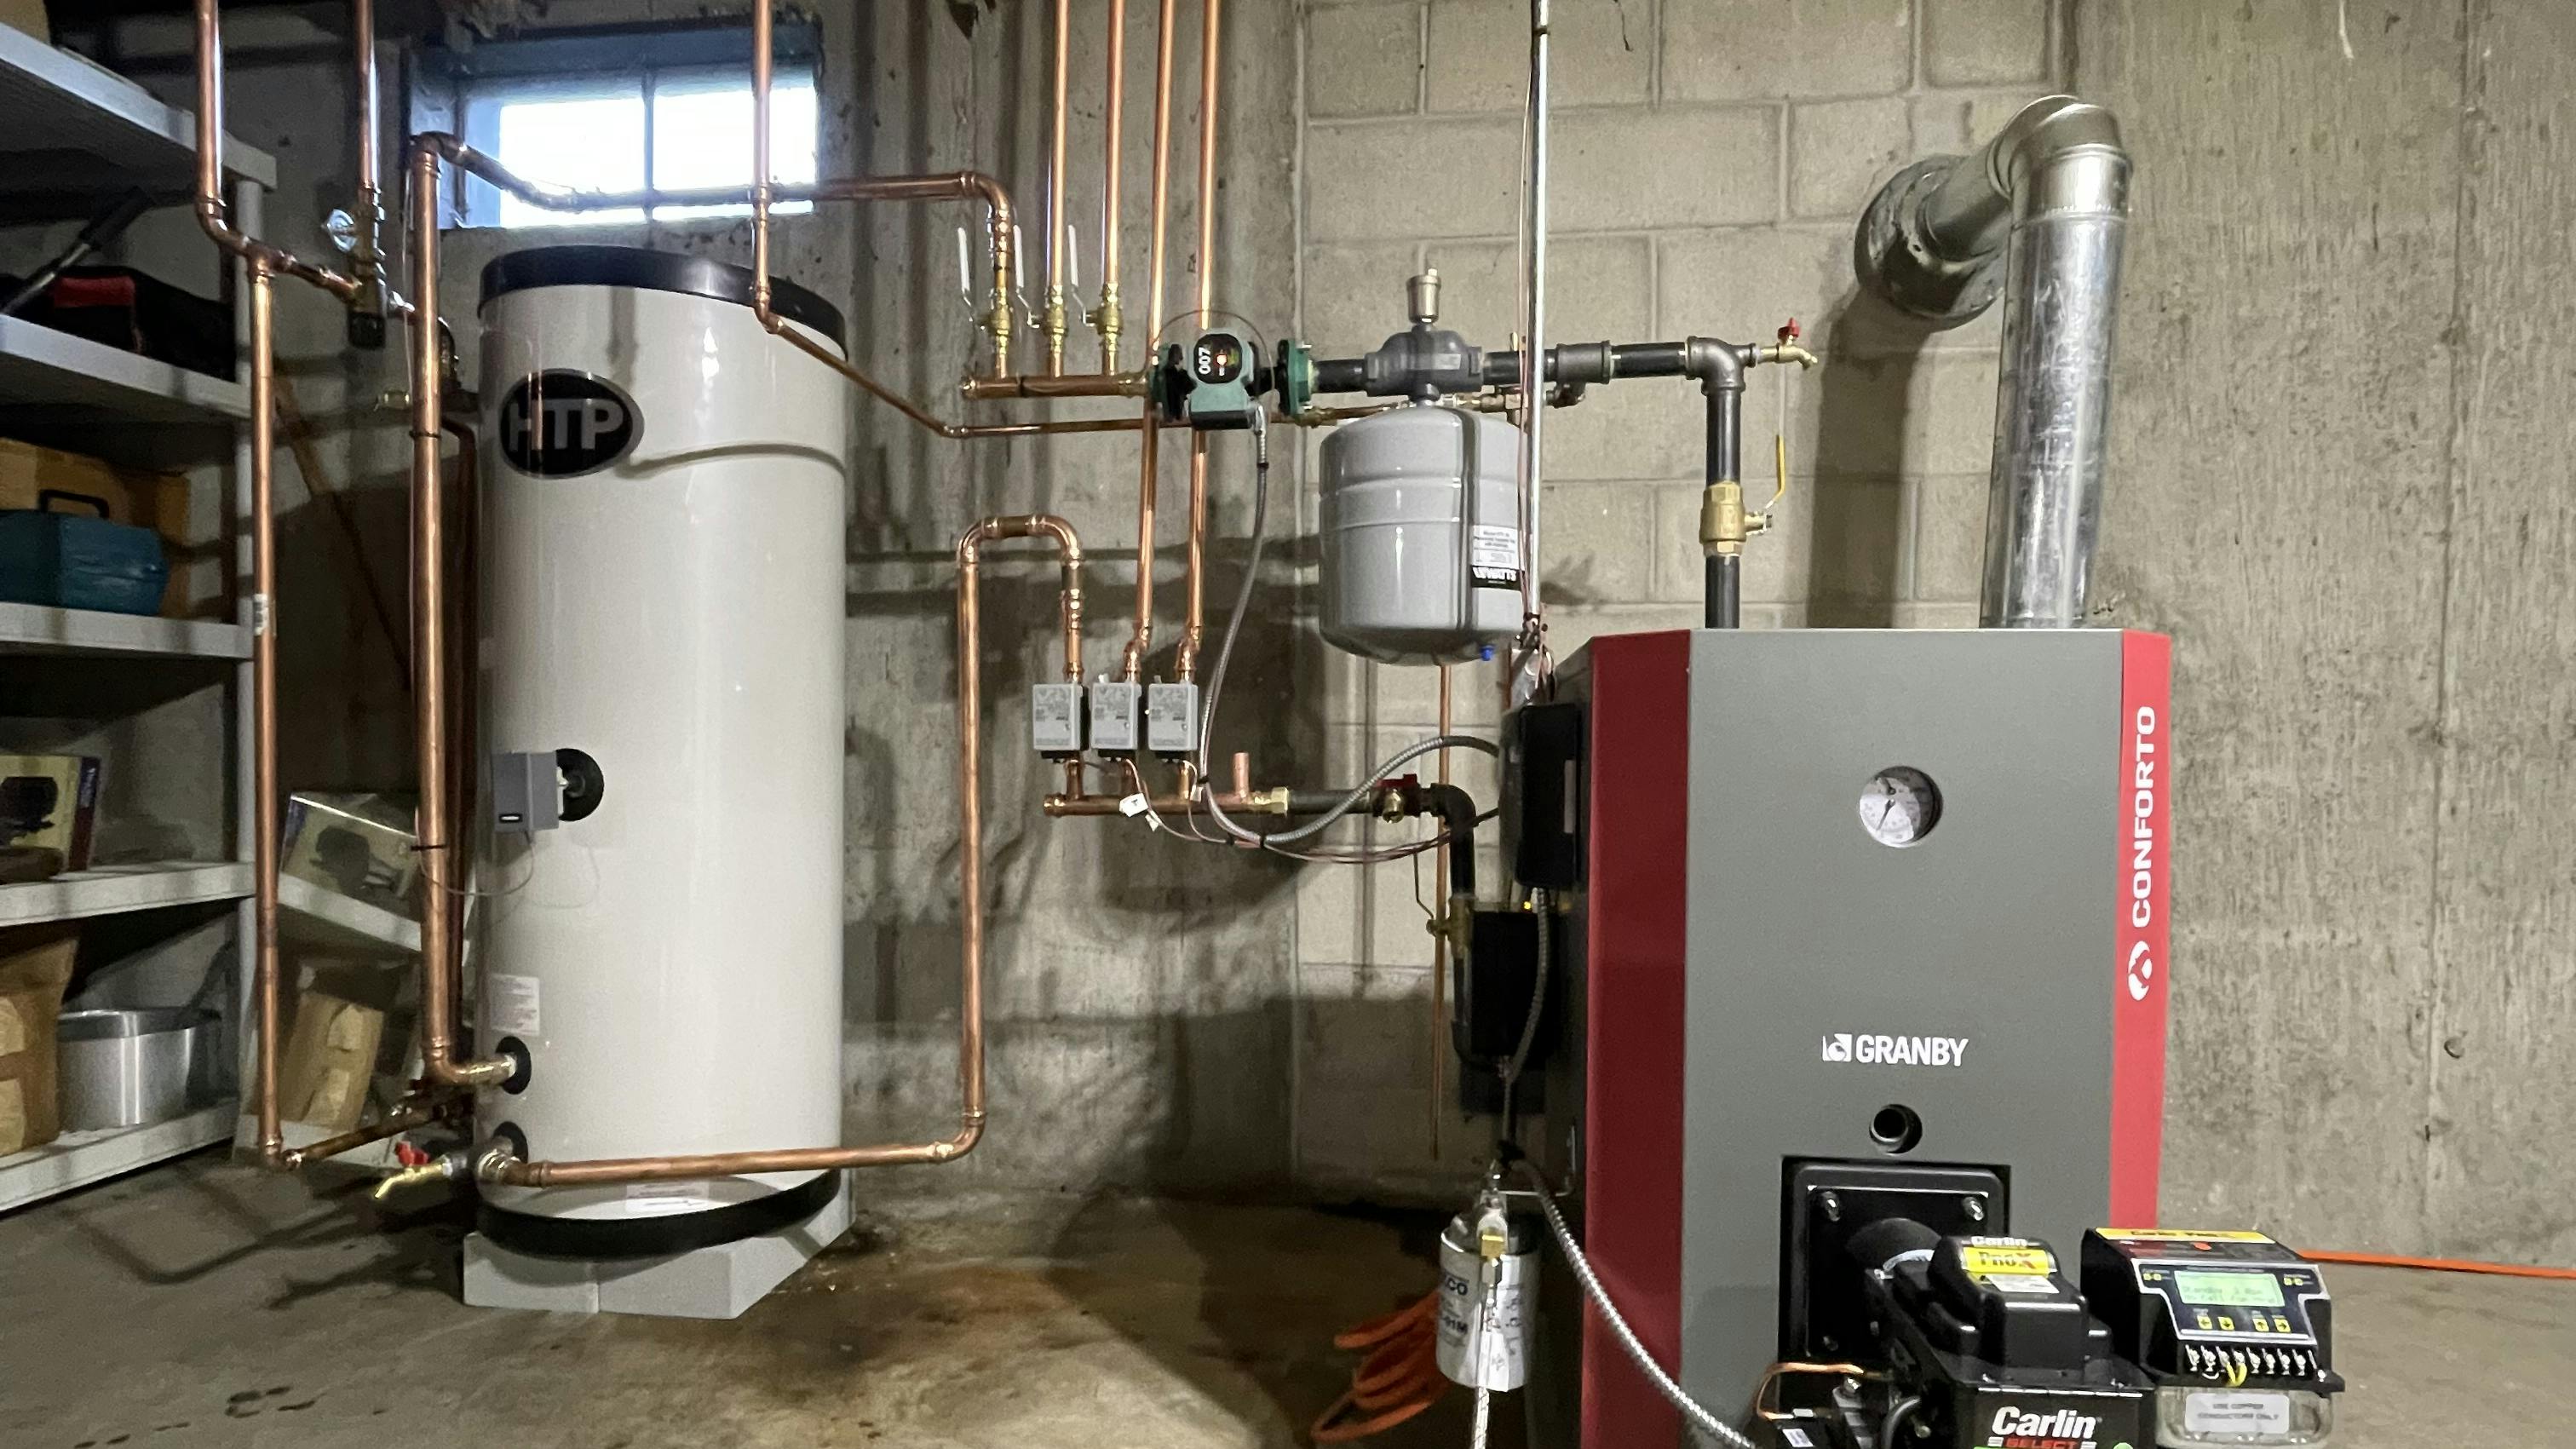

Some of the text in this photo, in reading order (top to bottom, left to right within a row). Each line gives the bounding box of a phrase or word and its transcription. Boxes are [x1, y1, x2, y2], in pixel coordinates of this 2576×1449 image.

[1198, 347, 1211, 375] 007
[509, 399, 624, 451] HTP
[2132, 706, 2156, 928] CONFORTO
[1855, 1034, 1969, 1067] GRANBY
[1992, 1406, 2097, 1439] Carlin
